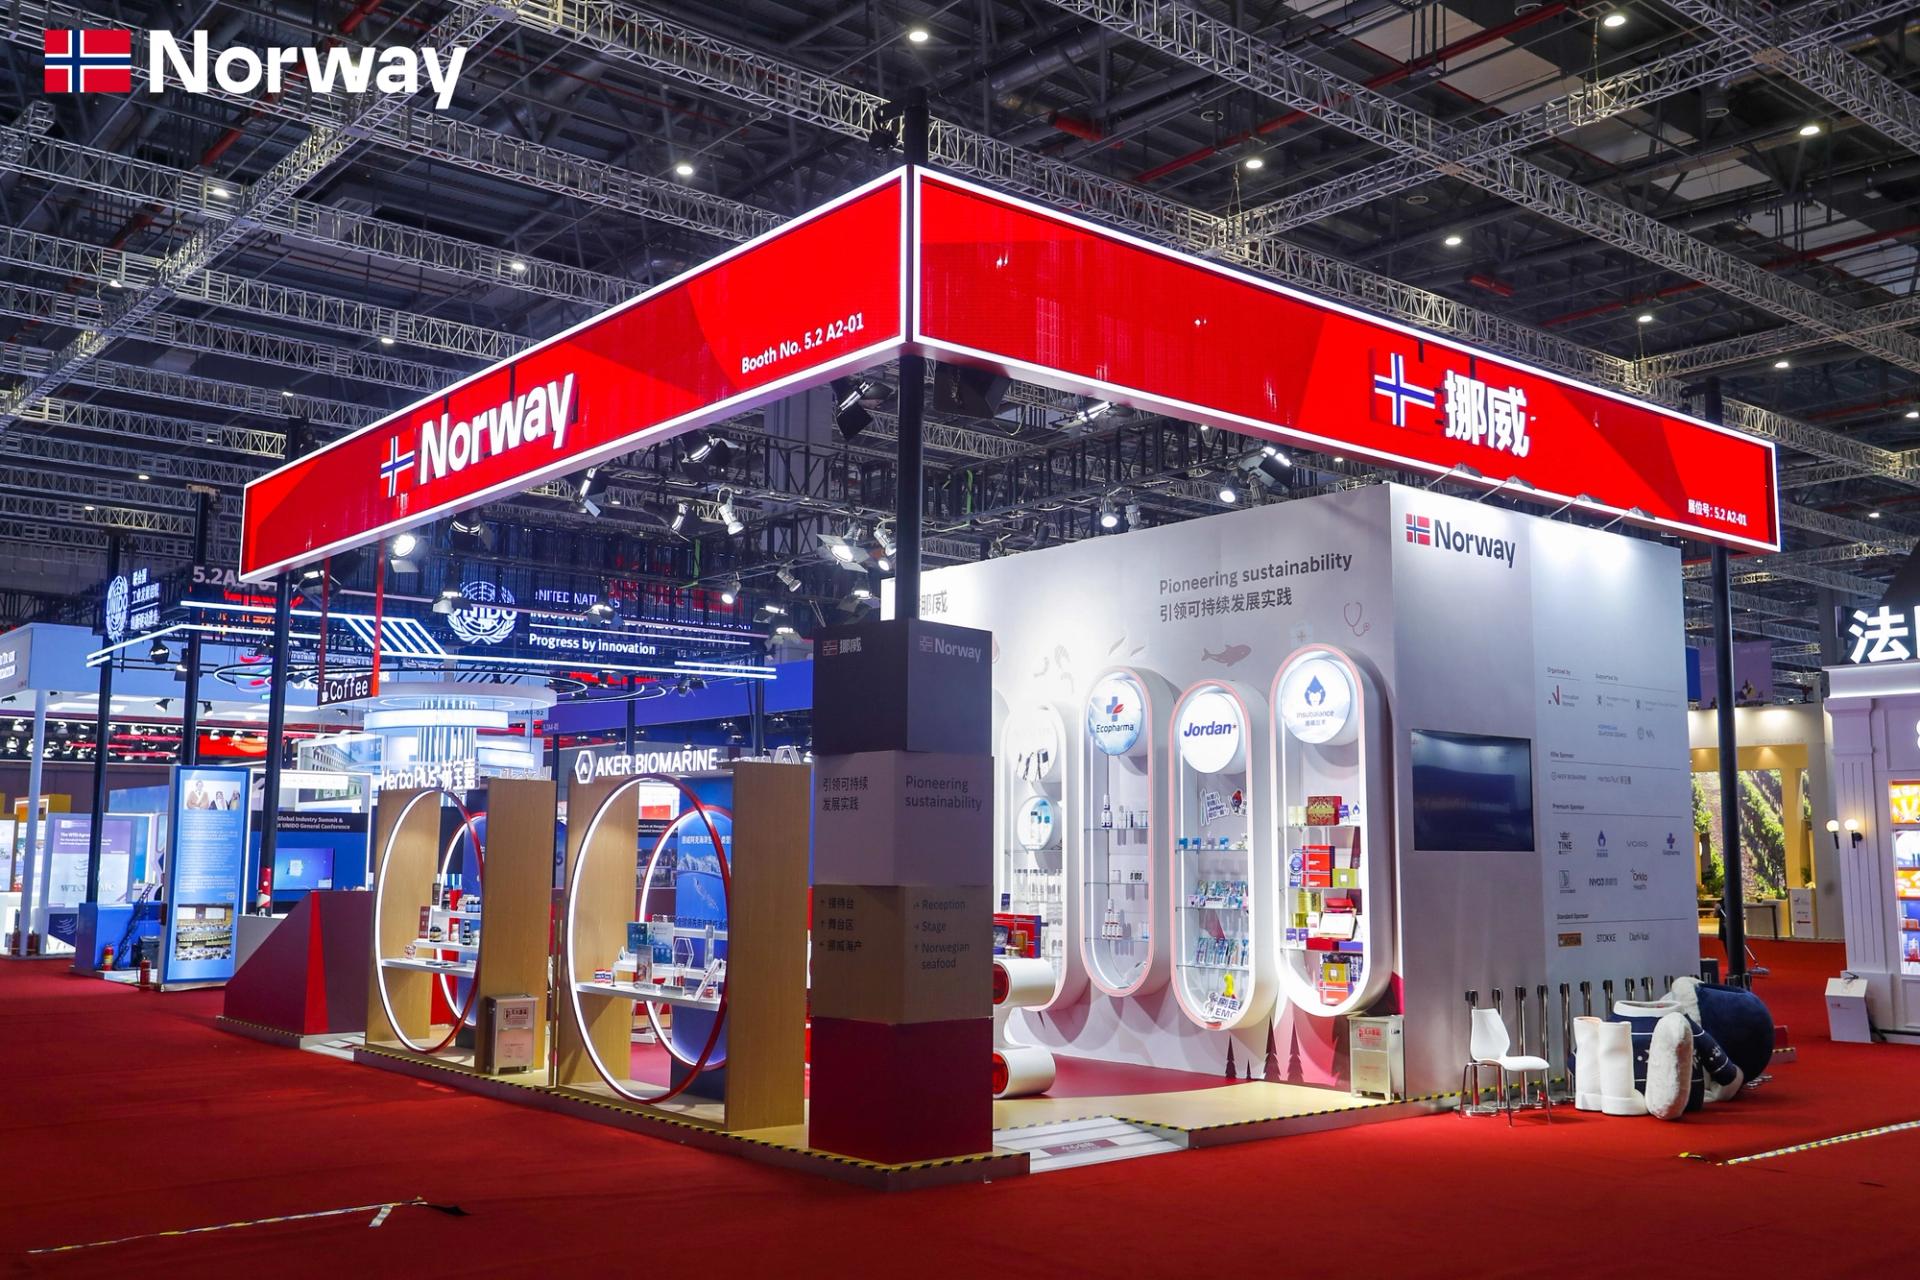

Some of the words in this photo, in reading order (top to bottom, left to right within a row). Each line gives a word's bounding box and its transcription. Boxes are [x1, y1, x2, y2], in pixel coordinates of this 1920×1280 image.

[741, 346, 777, 374] Booth
[779, 340, 802, 360] No.
[804, 327, 823, 350] 5.2
[825, 312, 864, 342] A2-01
[1444, 369, 1530, 458] 挪威
[419, 373, 575, 486] Norway
[1434, 519, 1516, 568] Norway
[1159, 570, 1239, 595] Pioneering
[1242, 553, 1353, 582] sustainability
[1160, 586, 1293, 622] 引领可持续发展实践
[529, 633, 580, 651] Progress
[582, 638, 596, 653] by
[1848, 605, 1920, 664] 法
[839, 637, 862, 654] 挪威
[934, 637, 982, 663] Norway
[329, 679, 368, 701] Coffee
[1096, 723, 1134, 734] Ecopharma
[1184, 721, 1232, 737] Jordan
[595, 755, 631, 777] AKER
[634, 748, 718, 774] BIOMARINE
[381, 768, 414, 790] Herba
[823, 776, 869, 792] 引领可持续
[905, 775, 969, 793] Pioneering
[822, 796, 860, 812] 发展实践
[905, 795, 983, 812] sustainability
[296, 815, 317, 824] Industry
[318, 816, 338, 824] Summit
[1558, 840, 1573, 850] TINE
[921, 900, 966, 912] Reception
[921, 921, 947, 934] Stage
[921, 942, 970, 954] Norwegian
[921, 958, 957, 970] seafood
